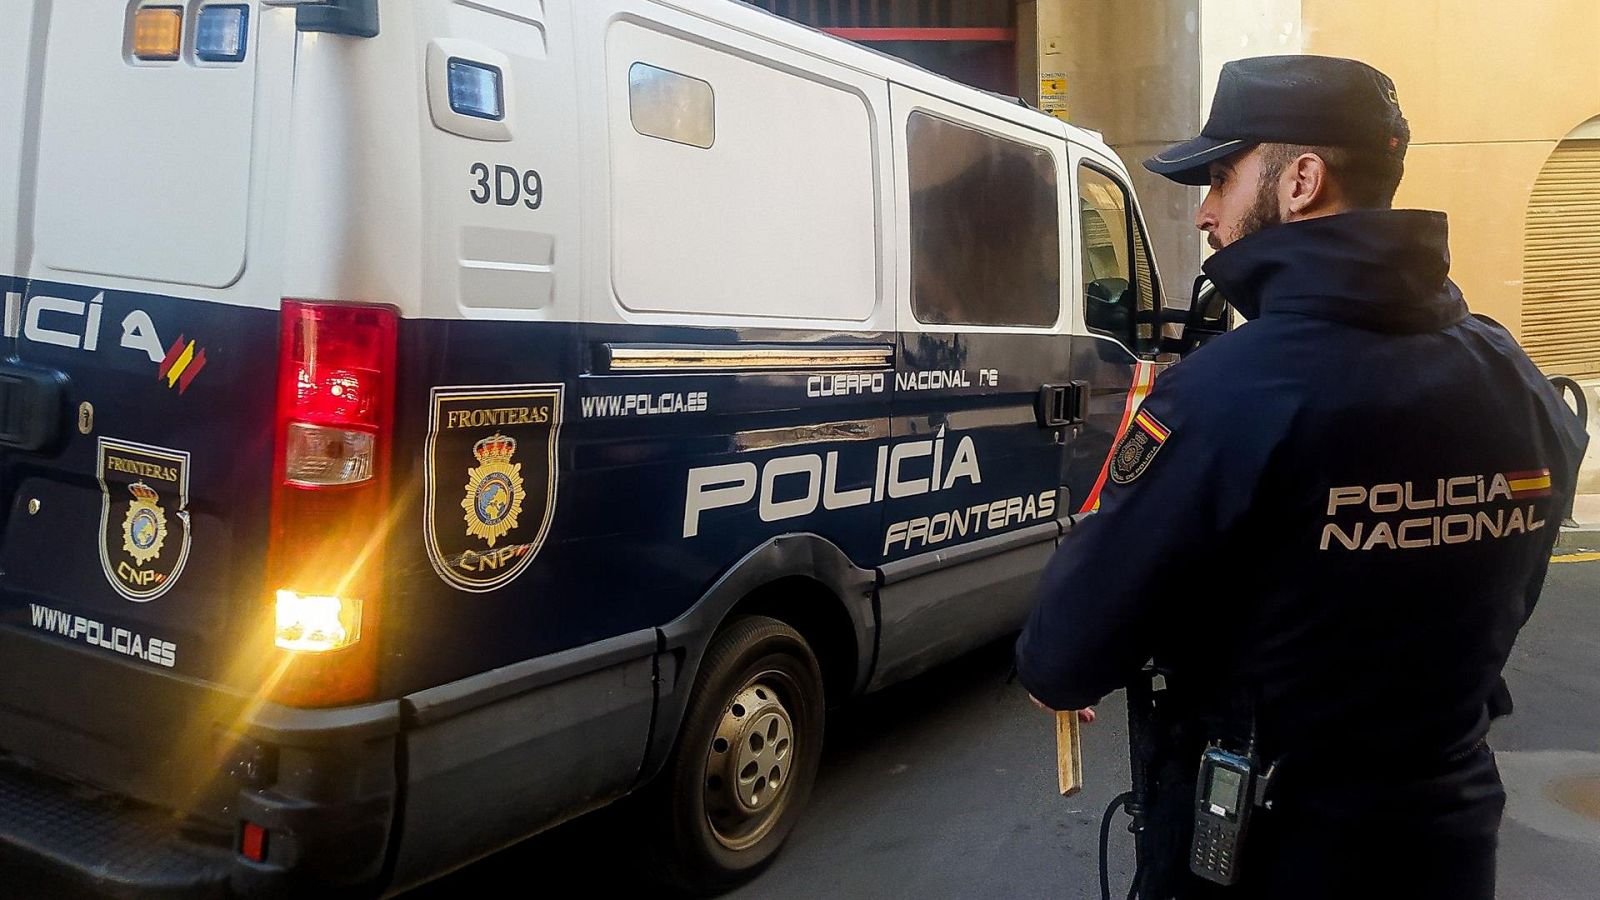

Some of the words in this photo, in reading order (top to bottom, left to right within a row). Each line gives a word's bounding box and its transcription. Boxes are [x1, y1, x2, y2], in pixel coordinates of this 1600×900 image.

[469, 162, 543, 210] 3D9
[806, 373, 885, 398] CUERPO
[895, 369, 971, 392] NACIONAL
[447, 406, 549, 429] FRONTERAS
[581, 392, 708, 418] WWW.POLICIA.ES
[108, 455, 177, 483] FRONTERAS
[682, 424, 982, 539] POLICÍA
[883, 490, 1057, 557] FRONTERAS
[1319, 504, 1545, 551] NACIONAL
[117, 560, 155, 586] CNP
[460, 548, 515, 572] CNP
[30, 603, 177, 668] WWW.POLICIA.ES
